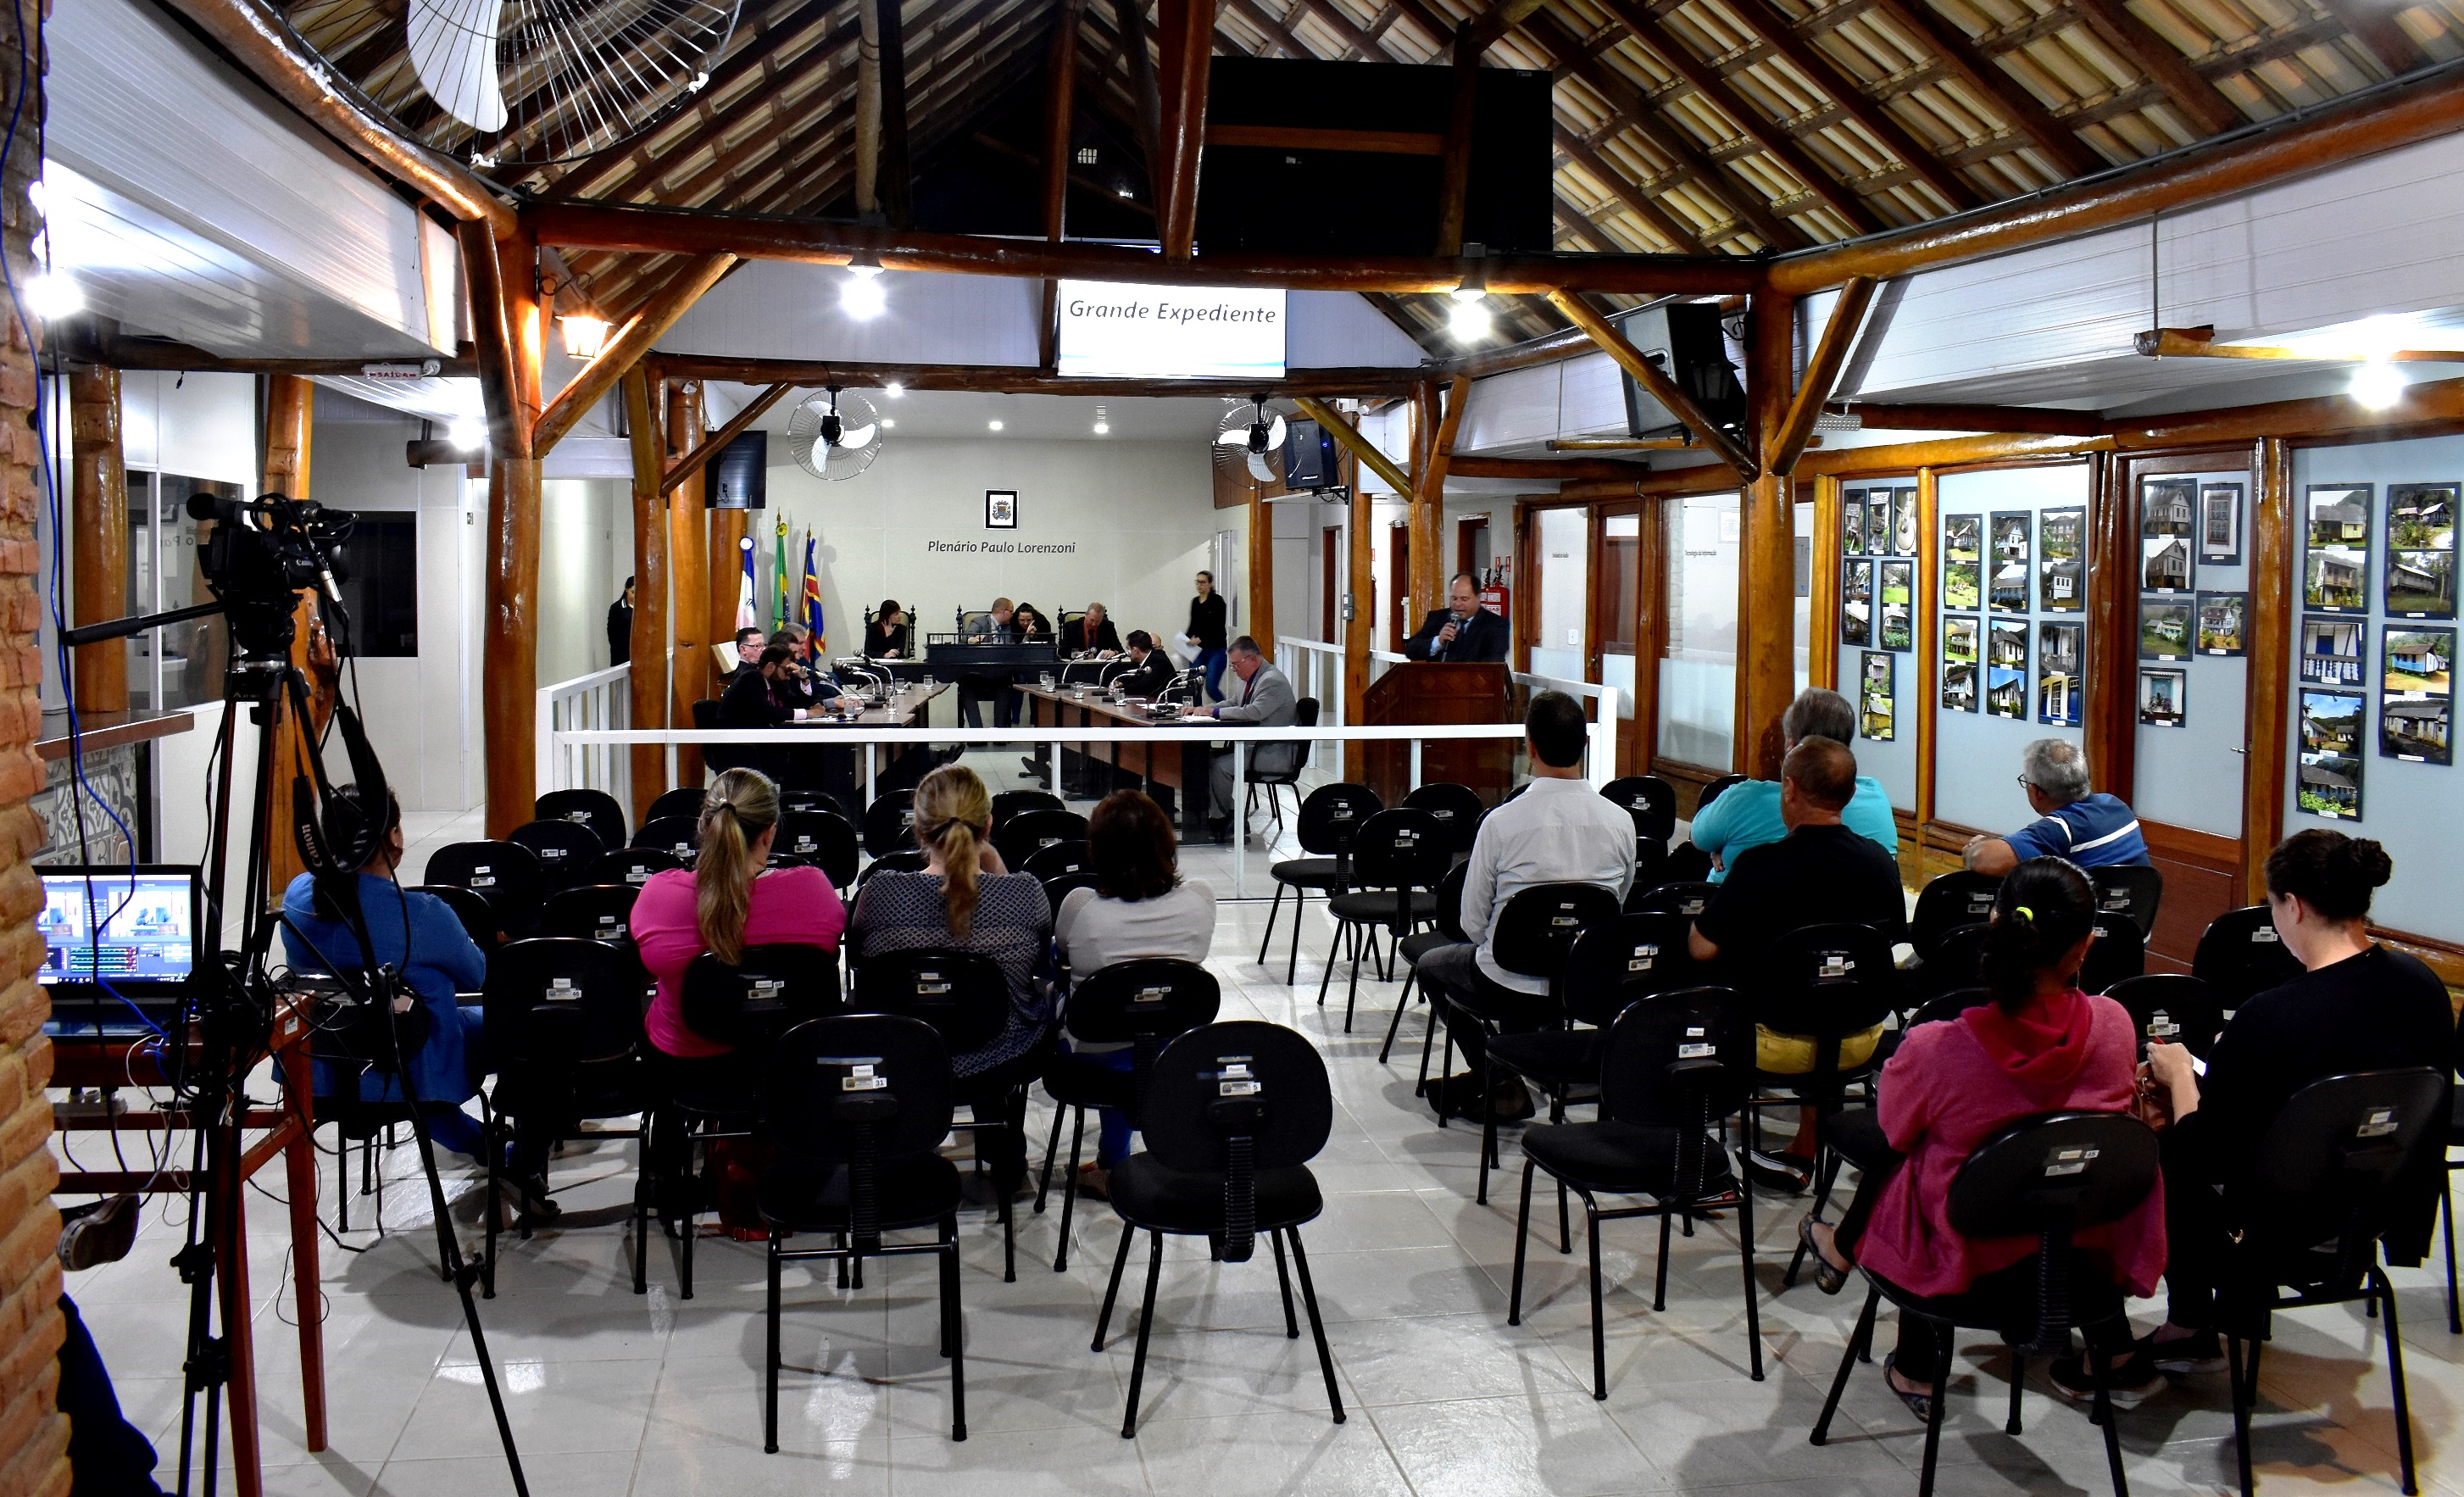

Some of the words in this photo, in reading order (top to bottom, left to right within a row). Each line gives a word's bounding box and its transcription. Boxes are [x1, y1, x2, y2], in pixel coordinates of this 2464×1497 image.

[1070, 299, 1149, 319] Grande
[1158, 303, 1276, 325] Expediente
[928, 540, 977, 552] Plenário
[981, 541, 1015, 553] Paulo
[1018, 542, 1076, 554] Lorenzoni
[302, 824, 323, 867] Canon
